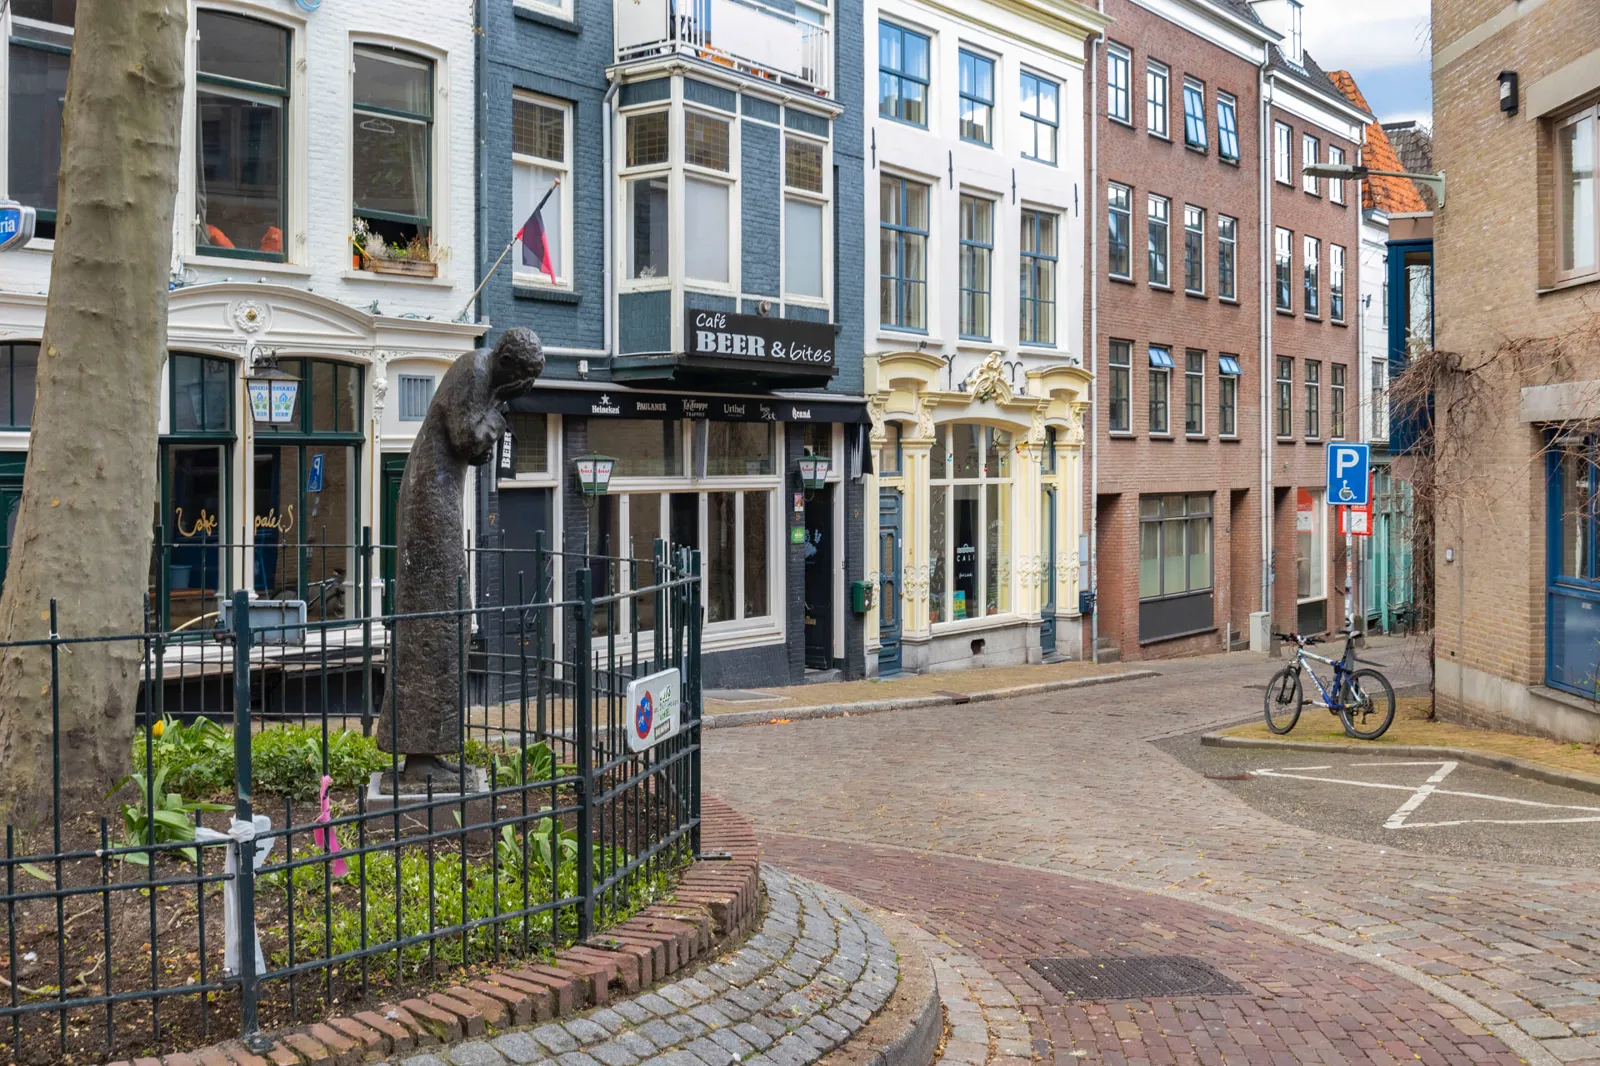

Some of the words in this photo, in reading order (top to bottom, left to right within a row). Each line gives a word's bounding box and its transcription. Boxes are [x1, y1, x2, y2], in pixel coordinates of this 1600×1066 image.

[696, 313, 726, 329] Café
[696, 330, 765, 357] BEER
[770, 341, 786, 358] &
[790, 341, 832, 363] bites
[592, 405, 620, 414] Heineken
[636, 401, 667, 411] PAULANER
[723, 403, 745, 415] Urthel
[501, 431, 512, 469] BEER
[1336, 448, 1359, 478] P
